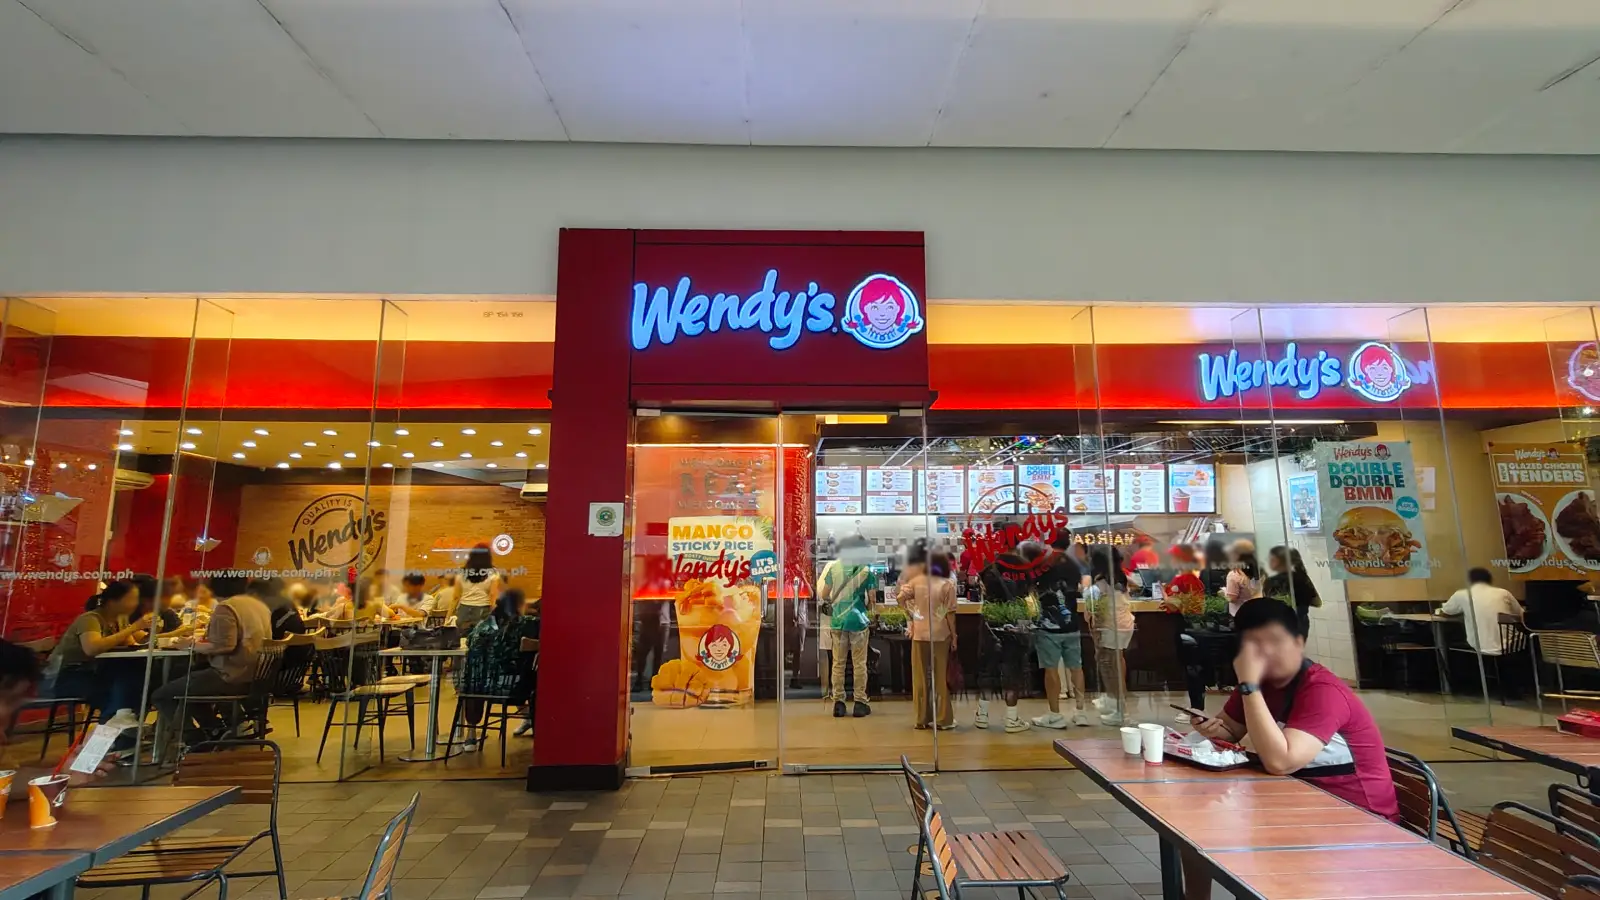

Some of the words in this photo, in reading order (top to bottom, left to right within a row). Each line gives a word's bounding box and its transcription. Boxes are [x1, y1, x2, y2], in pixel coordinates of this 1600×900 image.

[631, 268, 837, 350] Wendy's
[1199, 342, 1342, 401] Wendy's
[1333, 445, 1373, 460] Wendy's
[1327, 461, 1404, 475] DOUBLE
[1509, 462, 1543, 470] GLAZED
[1544, 462, 1583, 470] CHICKEN
[1329, 474, 1406, 488] DOUBLE
[1509, 469, 1586, 483] TENDERS
[1343, 486, 1394, 500] BMM
[302, 498, 341, 526] QUALITY
[343, 499, 353, 507] IS
[672, 524, 754, 540] MANGO
[964, 502, 1069, 573] Wendy's
[288, 509, 387, 571] Wendy's
[672, 541, 720, 551] STICKY
[724, 541, 754, 550] RICE
[755, 556, 774, 566] IT'S
[190, 567, 332, 581] www.wendys.com.ph
